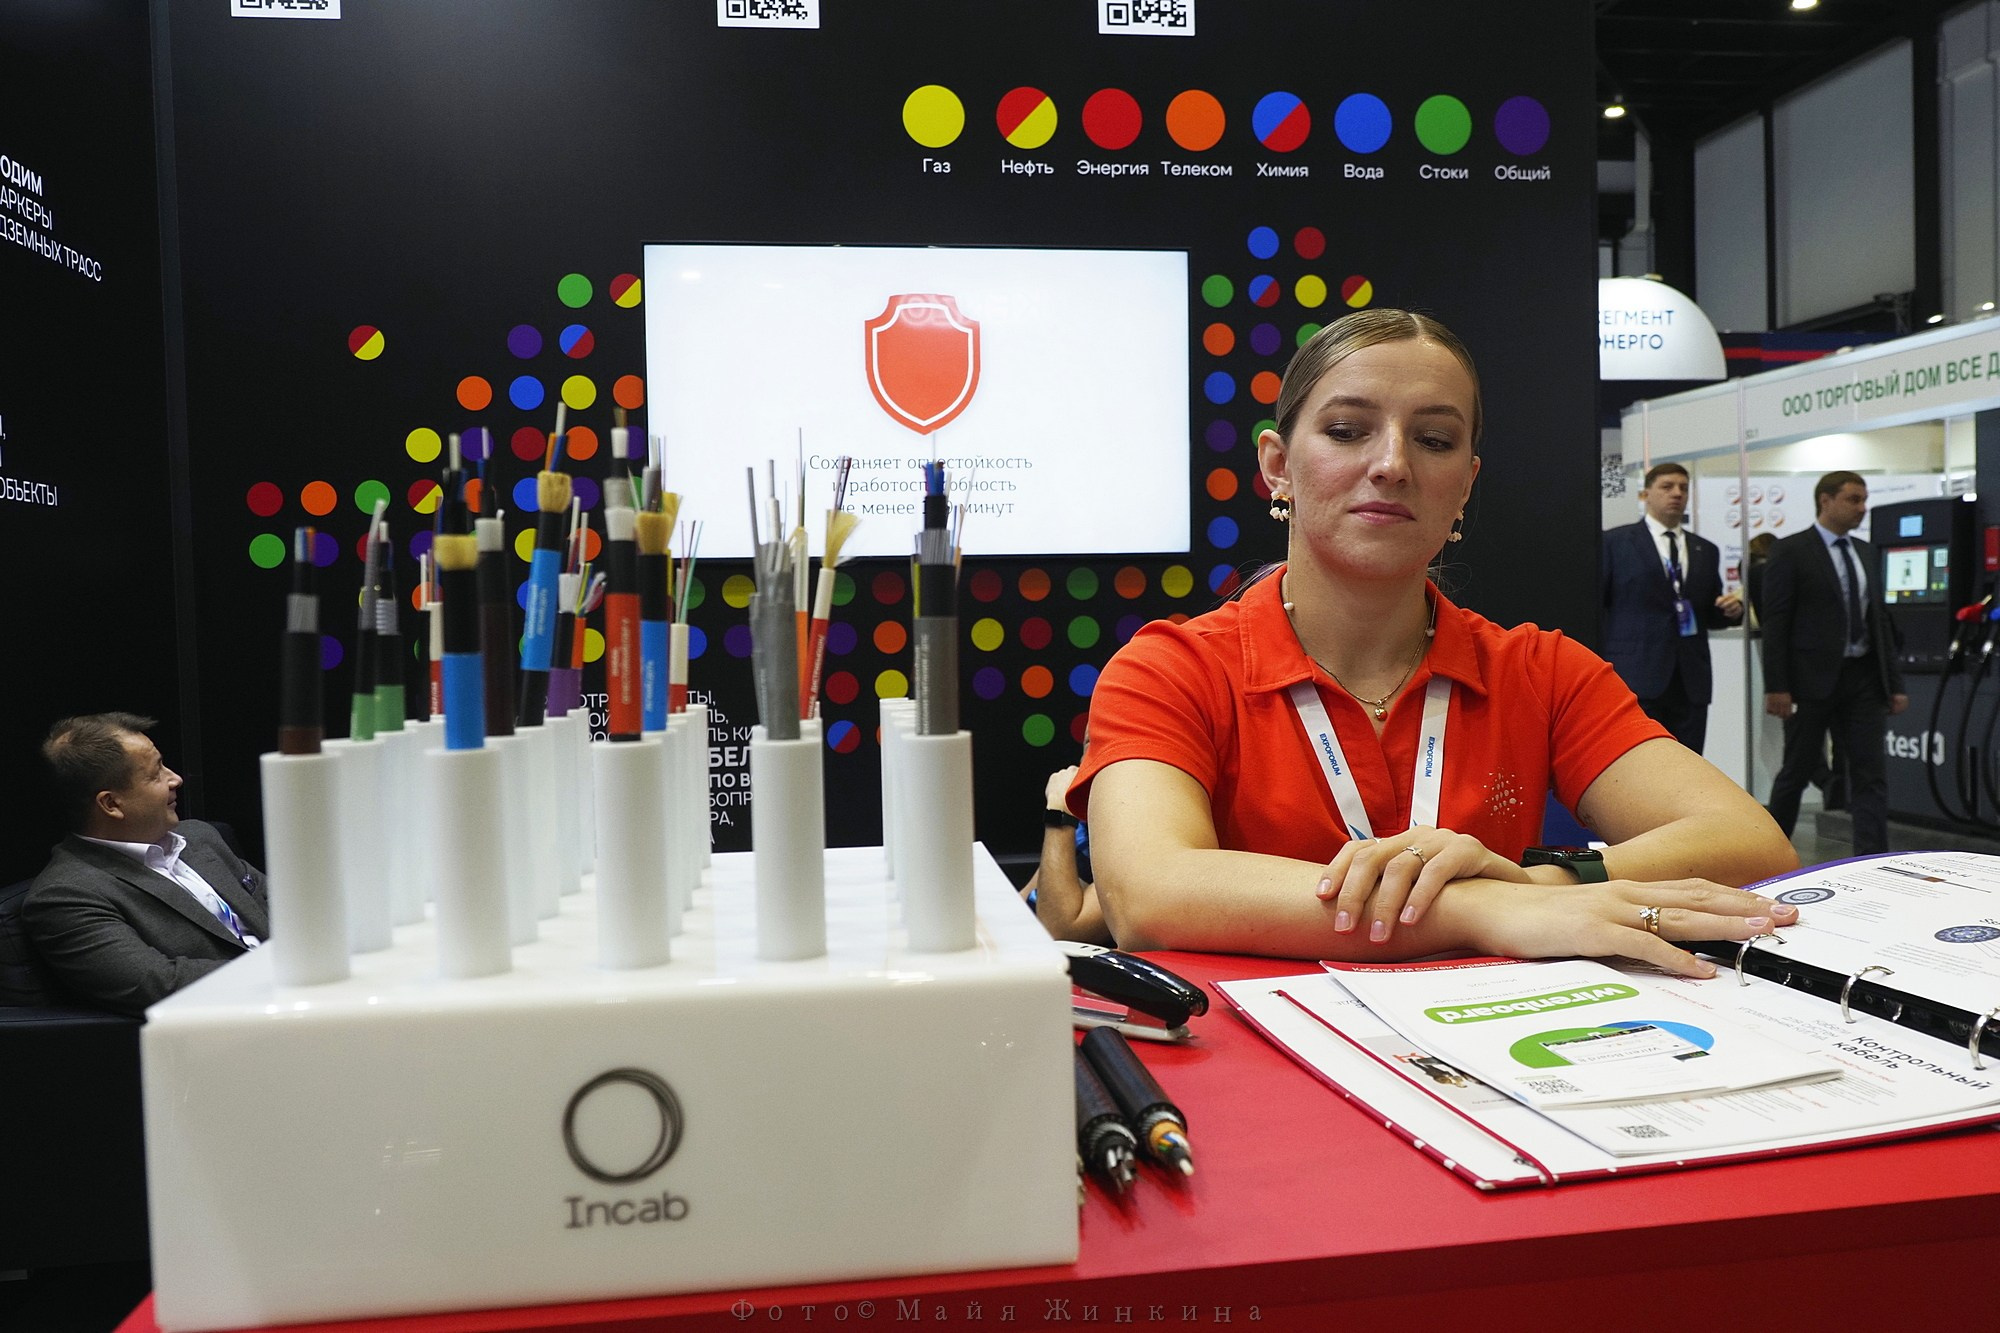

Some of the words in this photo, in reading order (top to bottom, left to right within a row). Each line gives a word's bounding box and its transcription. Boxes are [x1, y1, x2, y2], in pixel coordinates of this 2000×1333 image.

[923, 158, 951, 173] Газ
[1001, 159, 1054, 177] Нефть
[1077, 160, 1149, 178] Энергия
[1161, 161, 1232, 176] Телеком
[1256, 162, 1309, 177] Химия
[1344, 163, 1385, 180] Вода
[1419, 164, 1469, 179] Стоки
[1494, 165, 1551, 182] Общий
[63, 245, 102, 282] ТРАСС
[1599, 309, 1674, 325] ЕГМЕНТ
[1599, 334, 1663, 349] НЕРГО
[1782, 393, 1813, 416] ООО
[1816, 369, 1900, 410] ТОРГОВЫЙ
[1904, 365, 1941, 398] ДОМ
[1947, 356, 1981, 384] ВСЕ
[809, 454, 901, 474] Сохраняет
[862, 503, 915, 515] менее
[960, 502, 1014, 518] минут
[1319, 733, 1341, 776] EXPOFORUM
[1425, 736, 1436, 778] EXPOFORUM
[1437, 987, 1626, 1022] wirenboard
[1832, 1042, 1899, 1069] кабель
[1850, 1036, 1992, 1090] Контрольный
[564, 1190, 690, 1228] Incab
